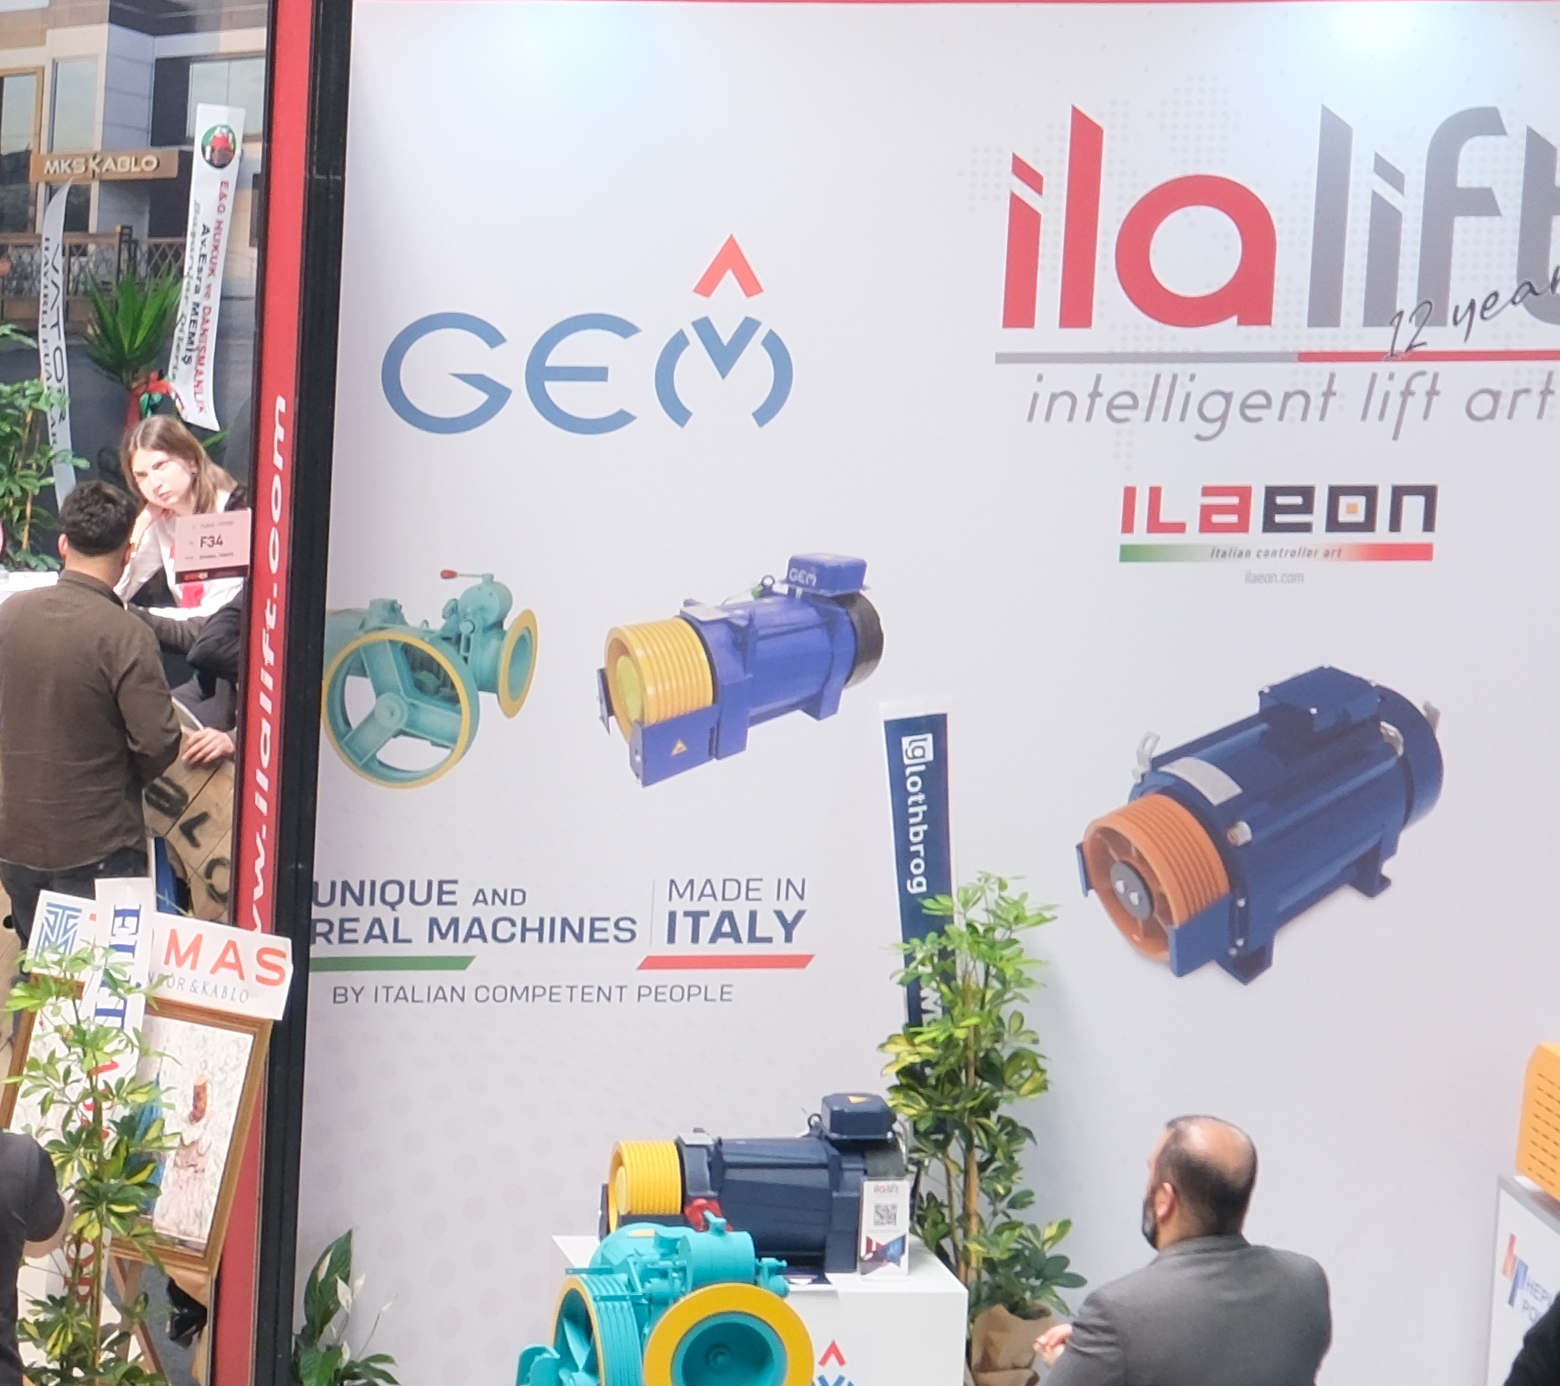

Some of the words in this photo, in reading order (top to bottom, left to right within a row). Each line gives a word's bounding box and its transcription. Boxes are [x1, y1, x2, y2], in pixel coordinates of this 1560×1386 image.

[44, 156, 88, 176] MKS
[89, 153, 160, 174] KABLO
[380, 310, 795, 437] GEM
[1026, 372, 1336, 442] intelligent
[1361, 370, 1442, 442] lift
[1465, 371, 1557, 422] art
[199, 535, 225, 549] F34
[1256, 546, 1320, 559] controller
[1322, 547, 1343, 559] art
[254, 393, 288, 935] ww.ilalift.com
[904, 763, 929, 895] lothbrog
[311, 879, 459, 912] UNIQUE
[472, 888, 527, 907] AND
[667, 878, 764, 902] MADE
[776, 877, 806, 901] IN
[311, 917, 412, 945] REAL
[427, 916, 637, 945] MACHINES
[667, 909, 808, 945] ITALY
[200, 980, 250, 1003] KABLO
[332, 985, 366, 1005] BY
[373, 985, 466, 1004] ITALIAN
[474, 984, 630, 1004] COMPETENT
[637, 984, 734, 1003] PEOPLE
